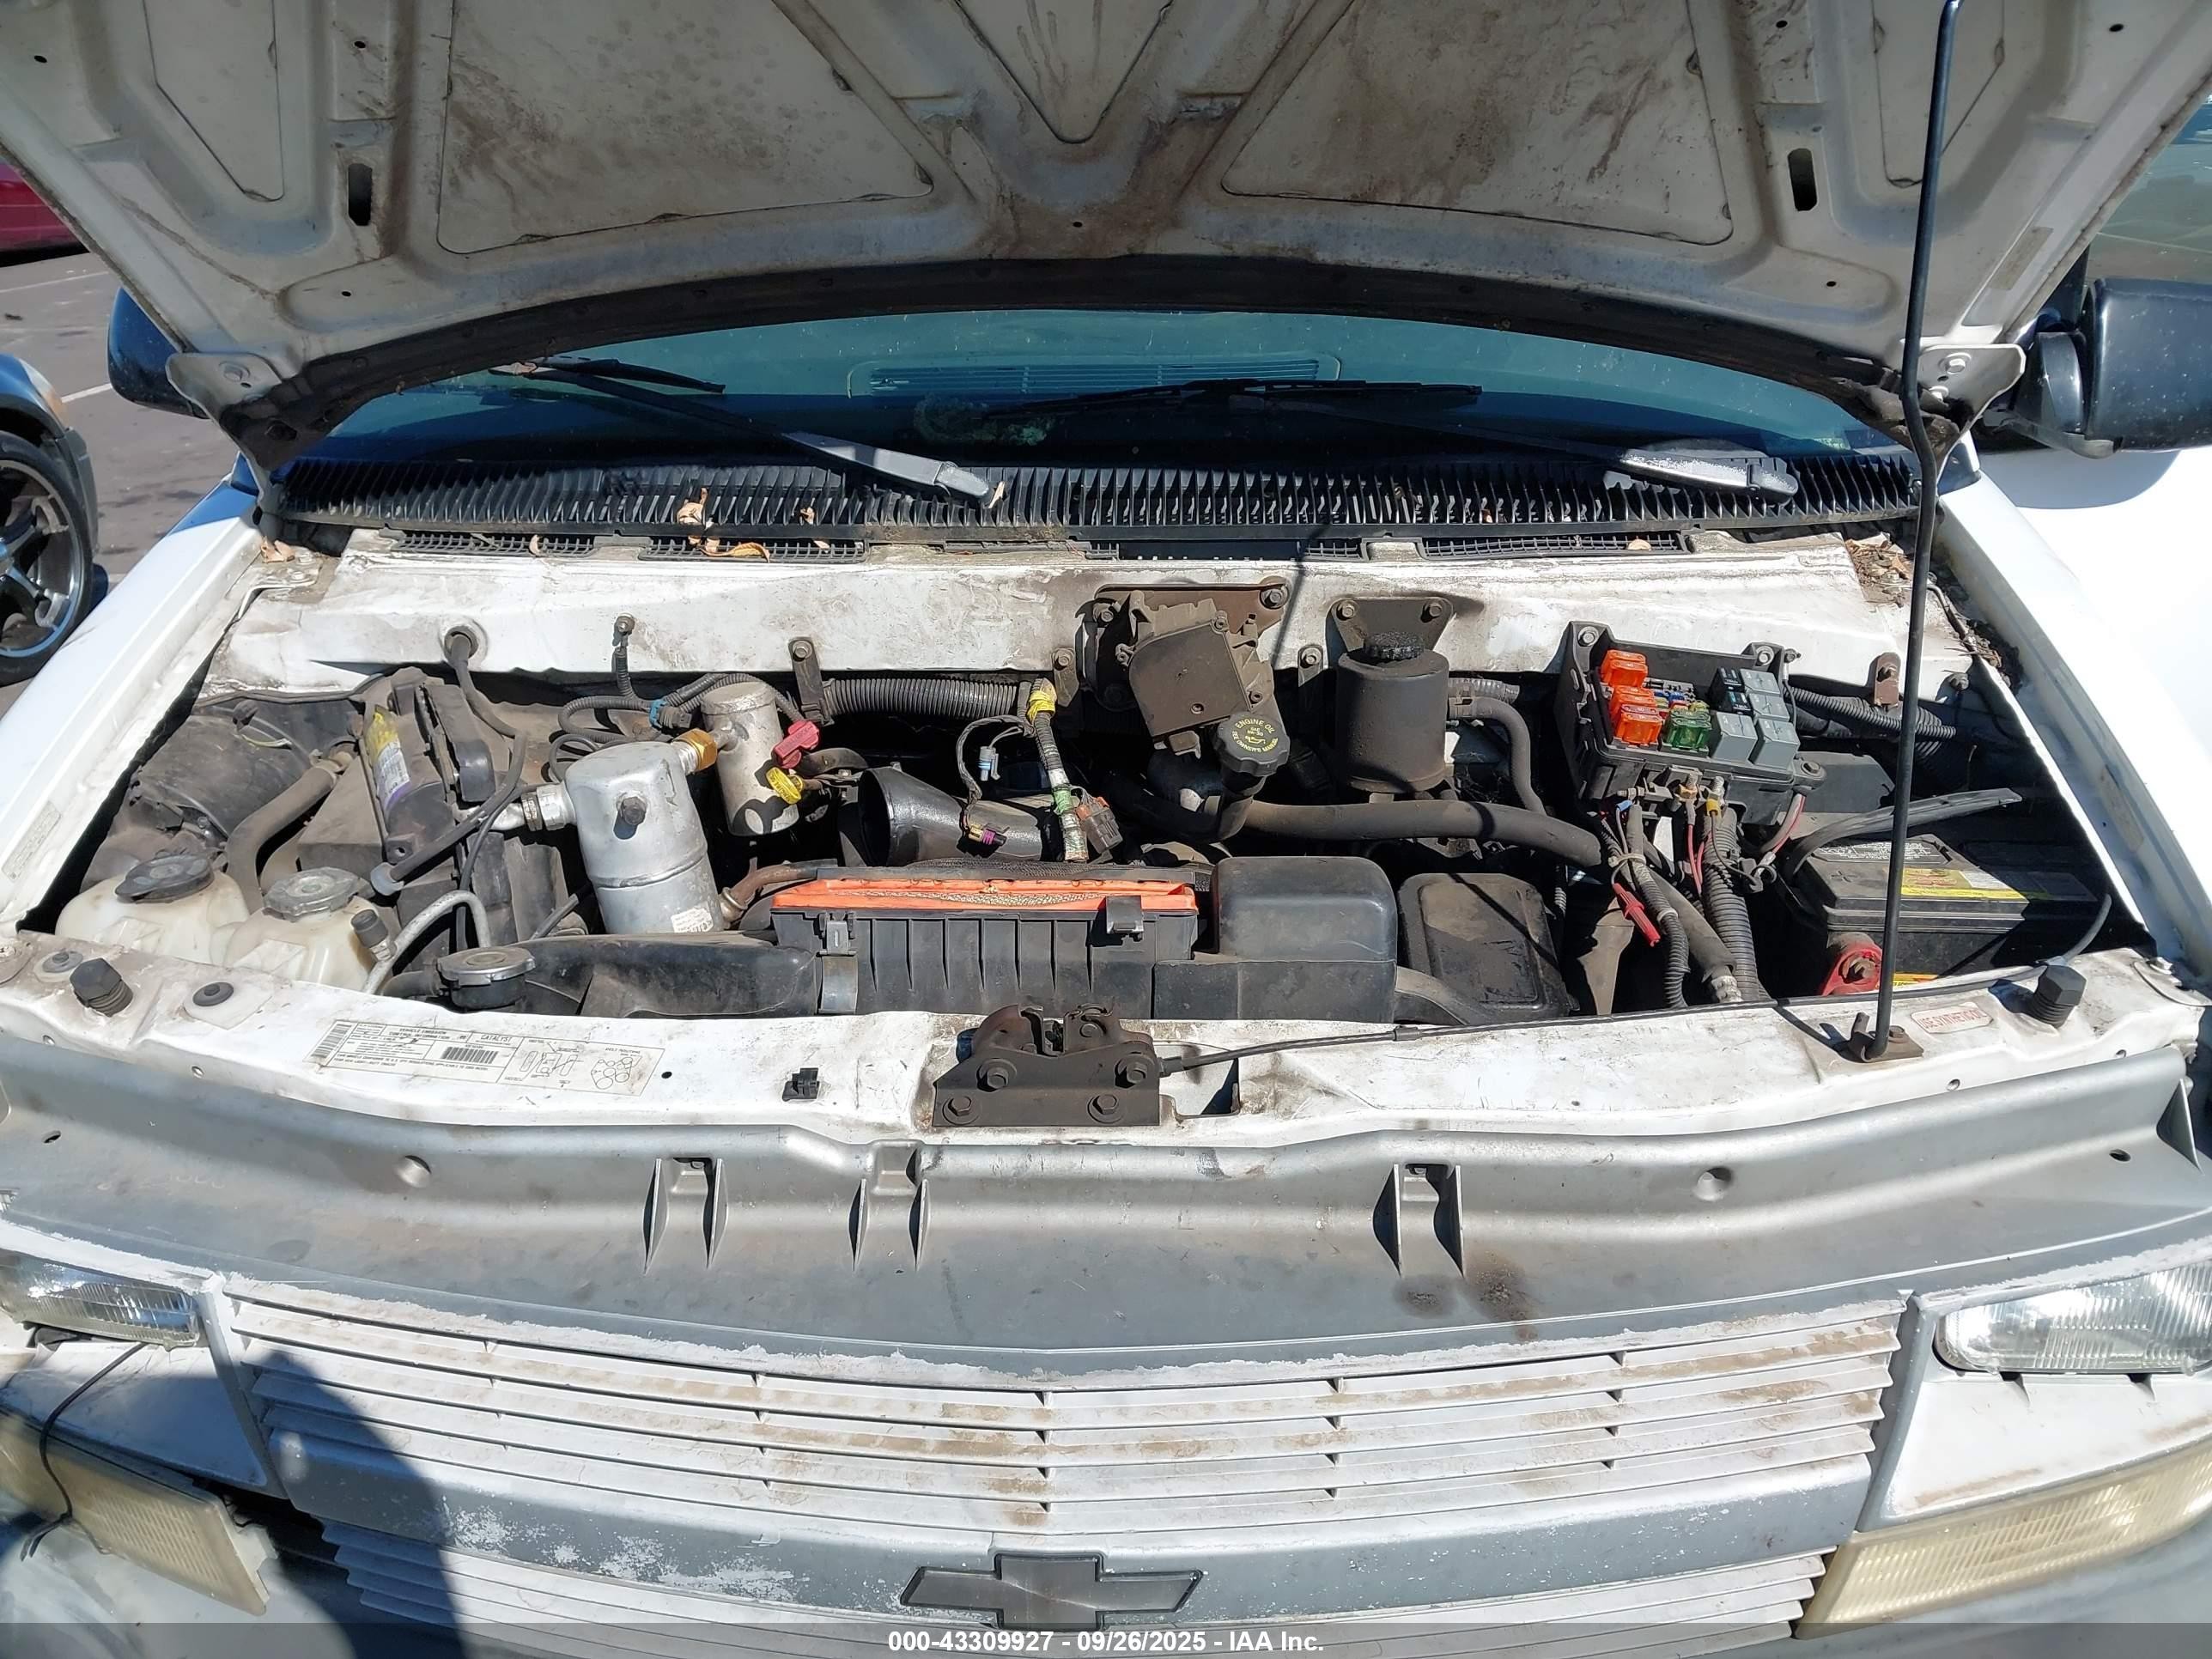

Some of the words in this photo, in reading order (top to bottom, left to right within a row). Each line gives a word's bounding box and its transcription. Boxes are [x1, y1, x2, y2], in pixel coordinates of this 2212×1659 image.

[1235, 718, 1264, 728] ENGINE
[1264, 724, 1276, 734] OIL
[481, 1034, 513, 1042] CATALYST
